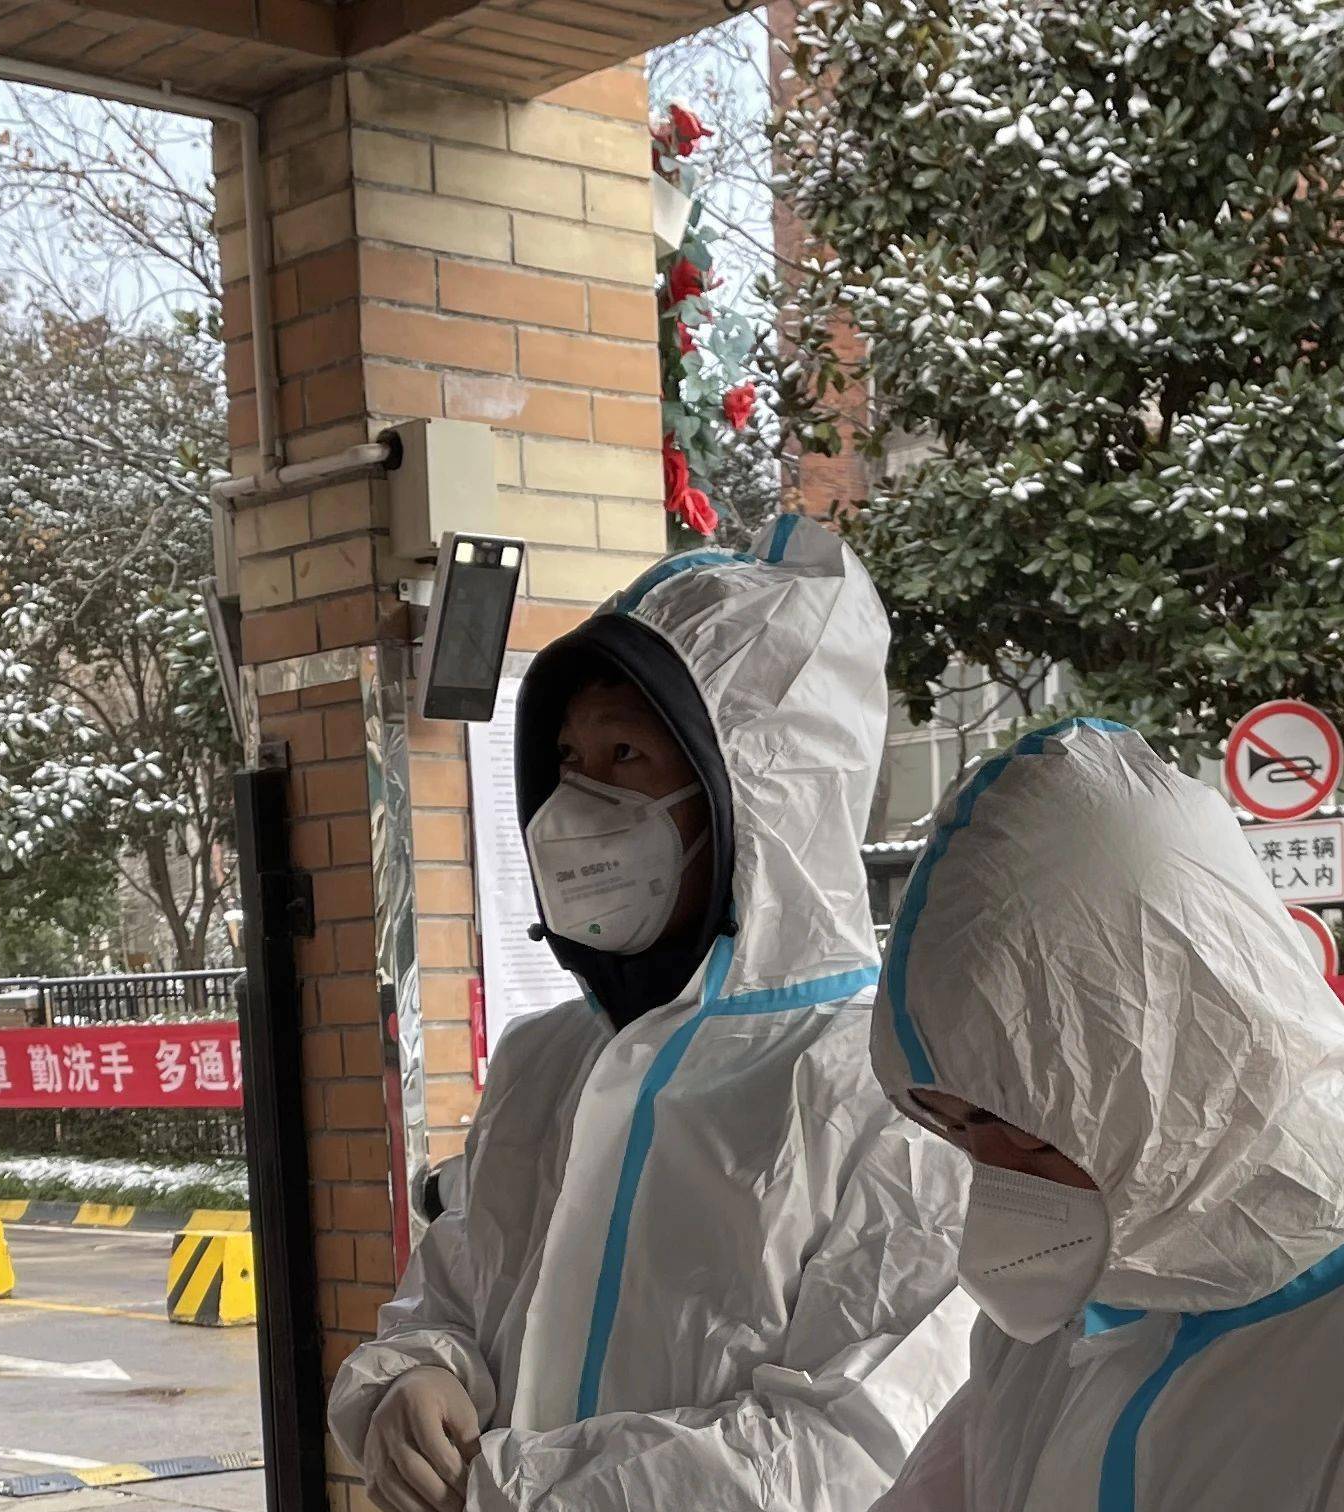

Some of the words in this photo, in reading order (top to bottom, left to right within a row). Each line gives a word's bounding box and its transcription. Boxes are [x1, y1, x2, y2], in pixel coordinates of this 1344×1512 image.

[1248, 836, 1335, 862] 来车辆
[27, 1041, 134, 1093] 勤洗手
[155, 1039, 242, 1092] 多通
